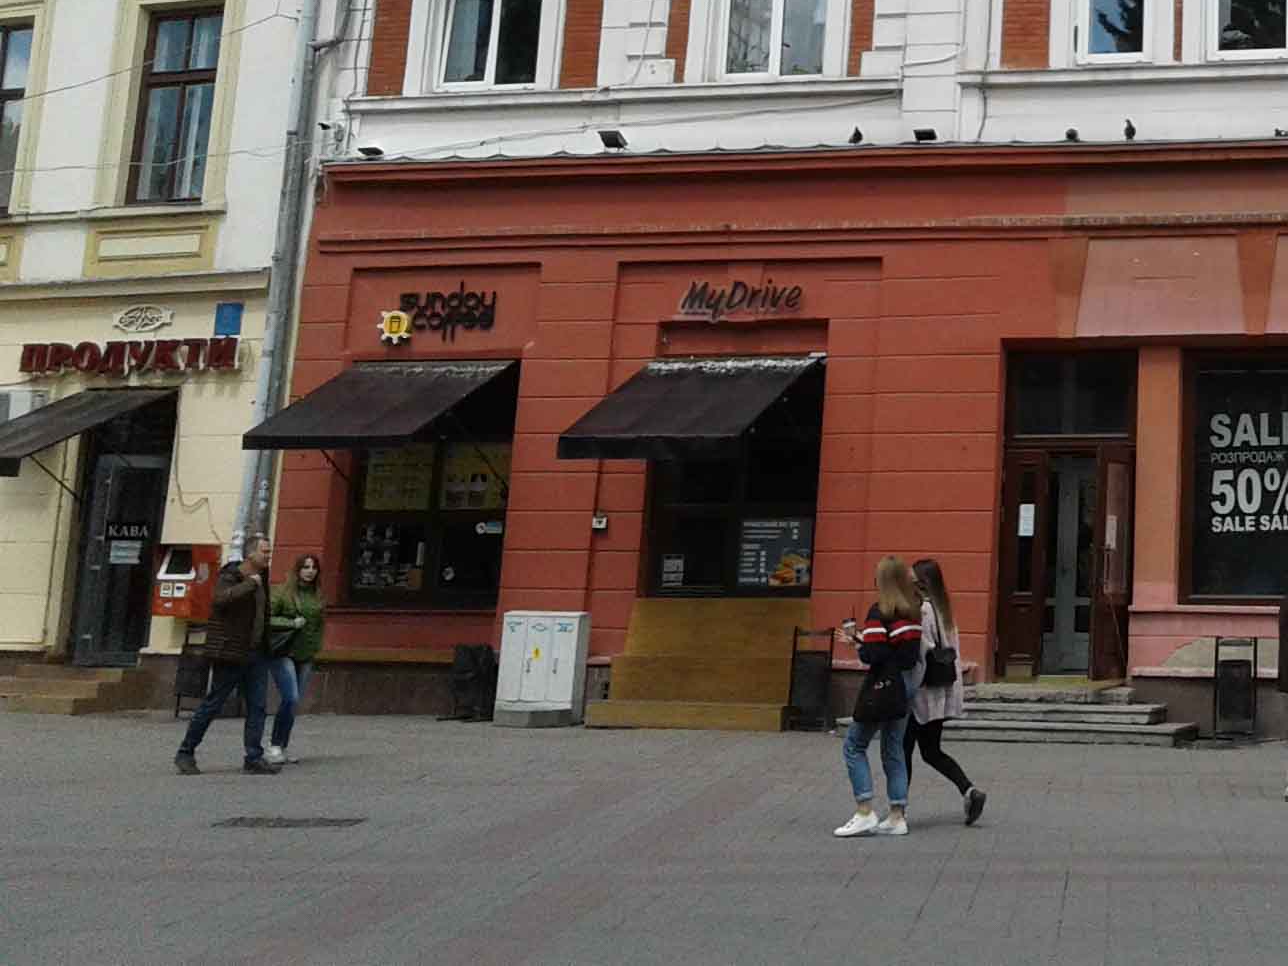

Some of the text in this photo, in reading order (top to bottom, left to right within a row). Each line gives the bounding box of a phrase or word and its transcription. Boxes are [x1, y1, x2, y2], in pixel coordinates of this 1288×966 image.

[400, 281, 496, 312] sunday
[680, 278, 803, 320] MyDrive
[412, 310, 495, 343] coffee
[19, 337, 239, 376] ПРОДУКТИ
[1211, 450, 1286, 464] РОЗПРОДАЖ
[109, 525, 148, 537] КАВА
[1211, 516, 1256, 532] SALE
